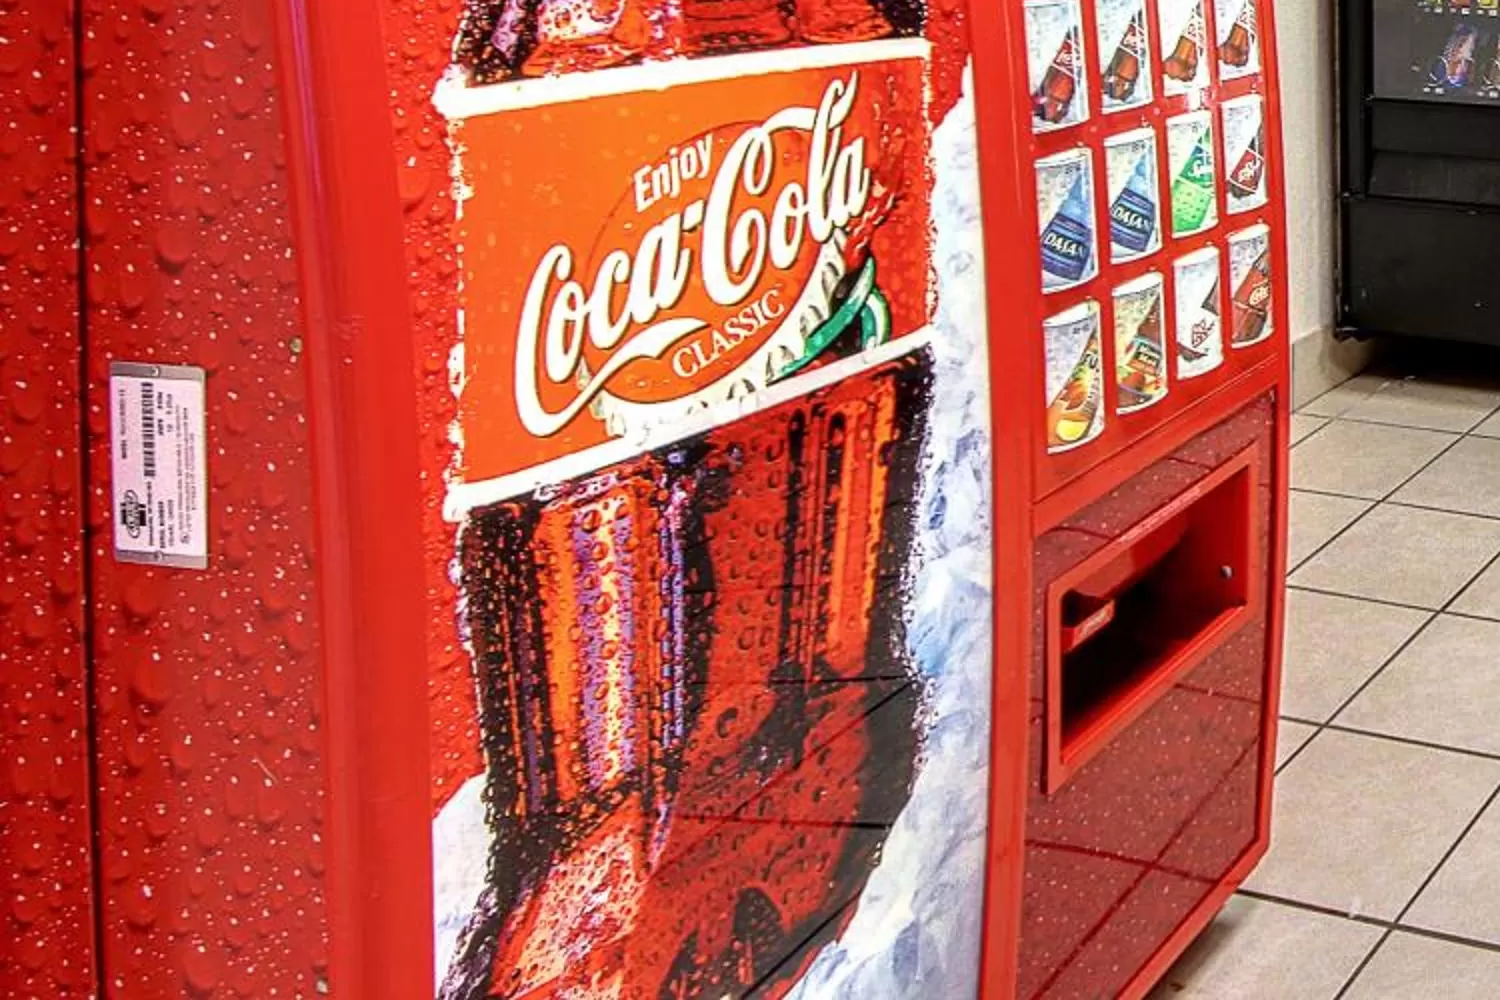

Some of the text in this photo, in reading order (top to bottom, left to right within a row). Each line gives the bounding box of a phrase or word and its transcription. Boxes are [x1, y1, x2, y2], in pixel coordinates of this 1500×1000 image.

[632, 133, 713, 213] Enjoy
[514, 70, 871, 437] Coca-Cola
[671, 286, 787, 378] CLASSIC
